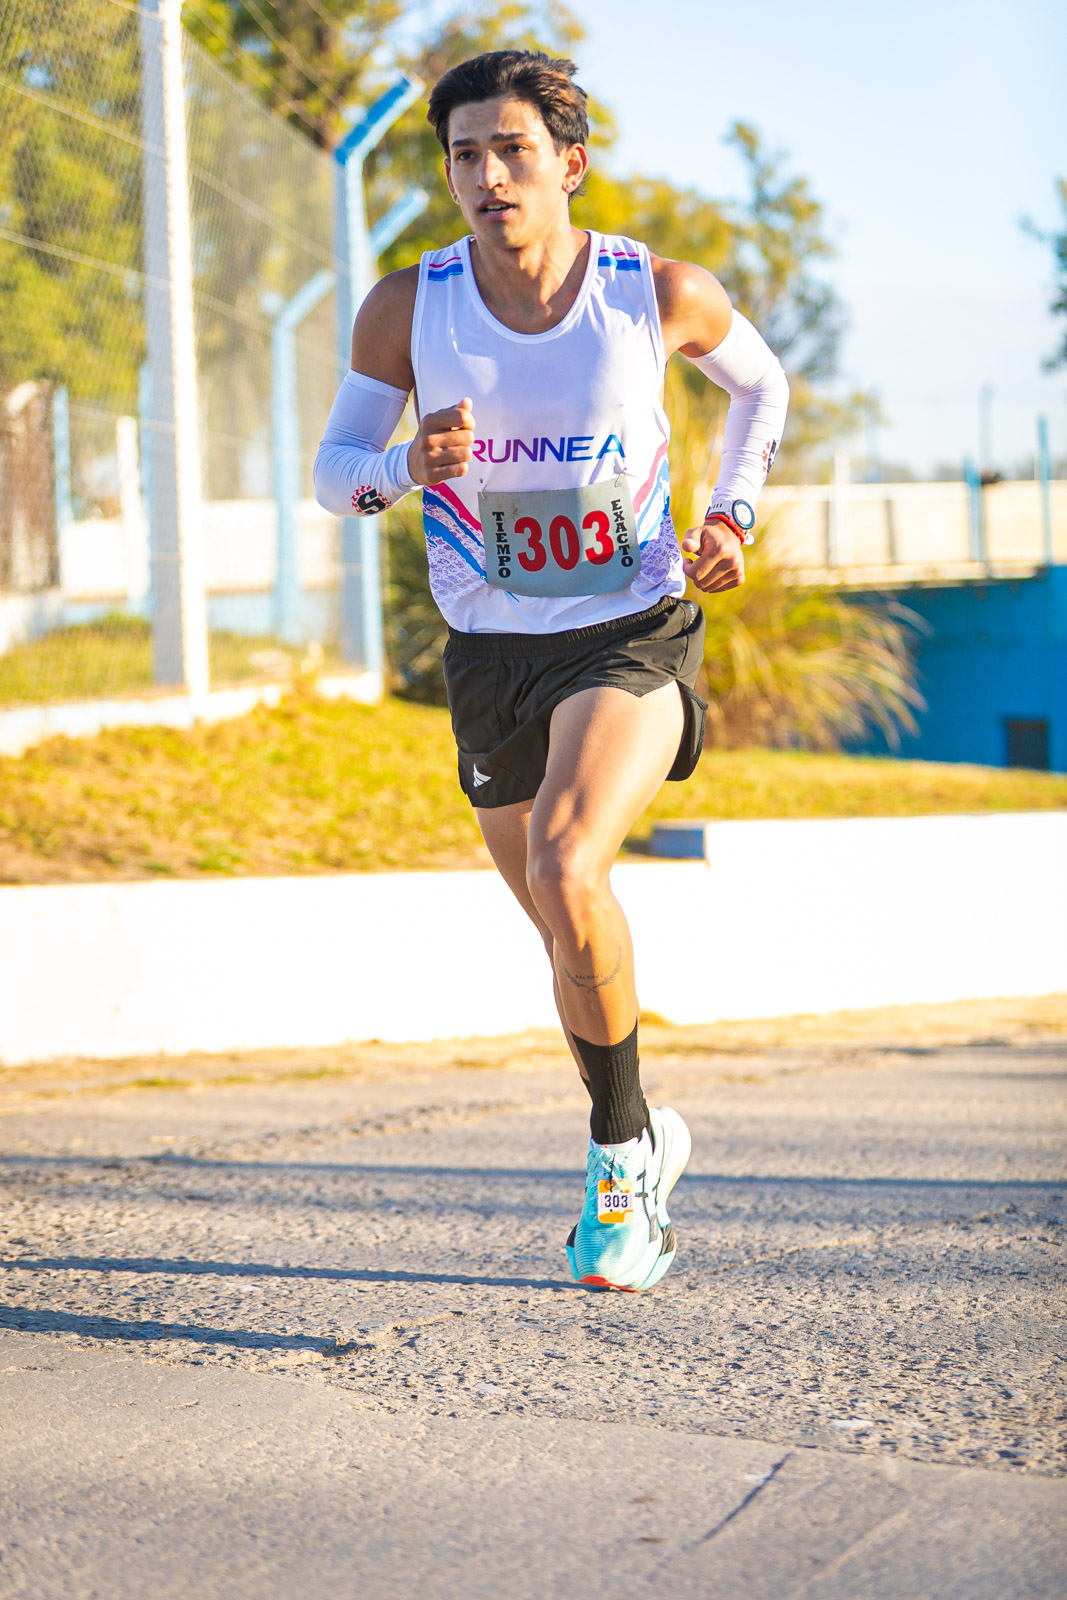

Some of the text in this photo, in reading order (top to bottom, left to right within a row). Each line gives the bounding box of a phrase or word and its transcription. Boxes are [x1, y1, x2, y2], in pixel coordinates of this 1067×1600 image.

[472, 434, 626, 464] RUNNEA
[492, 511, 511, 578] TIEMPO
[514, 510, 615, 572] 303
[611, 499, 634, 567] EXACTO
[604, 1194, 628, 1208] 303
